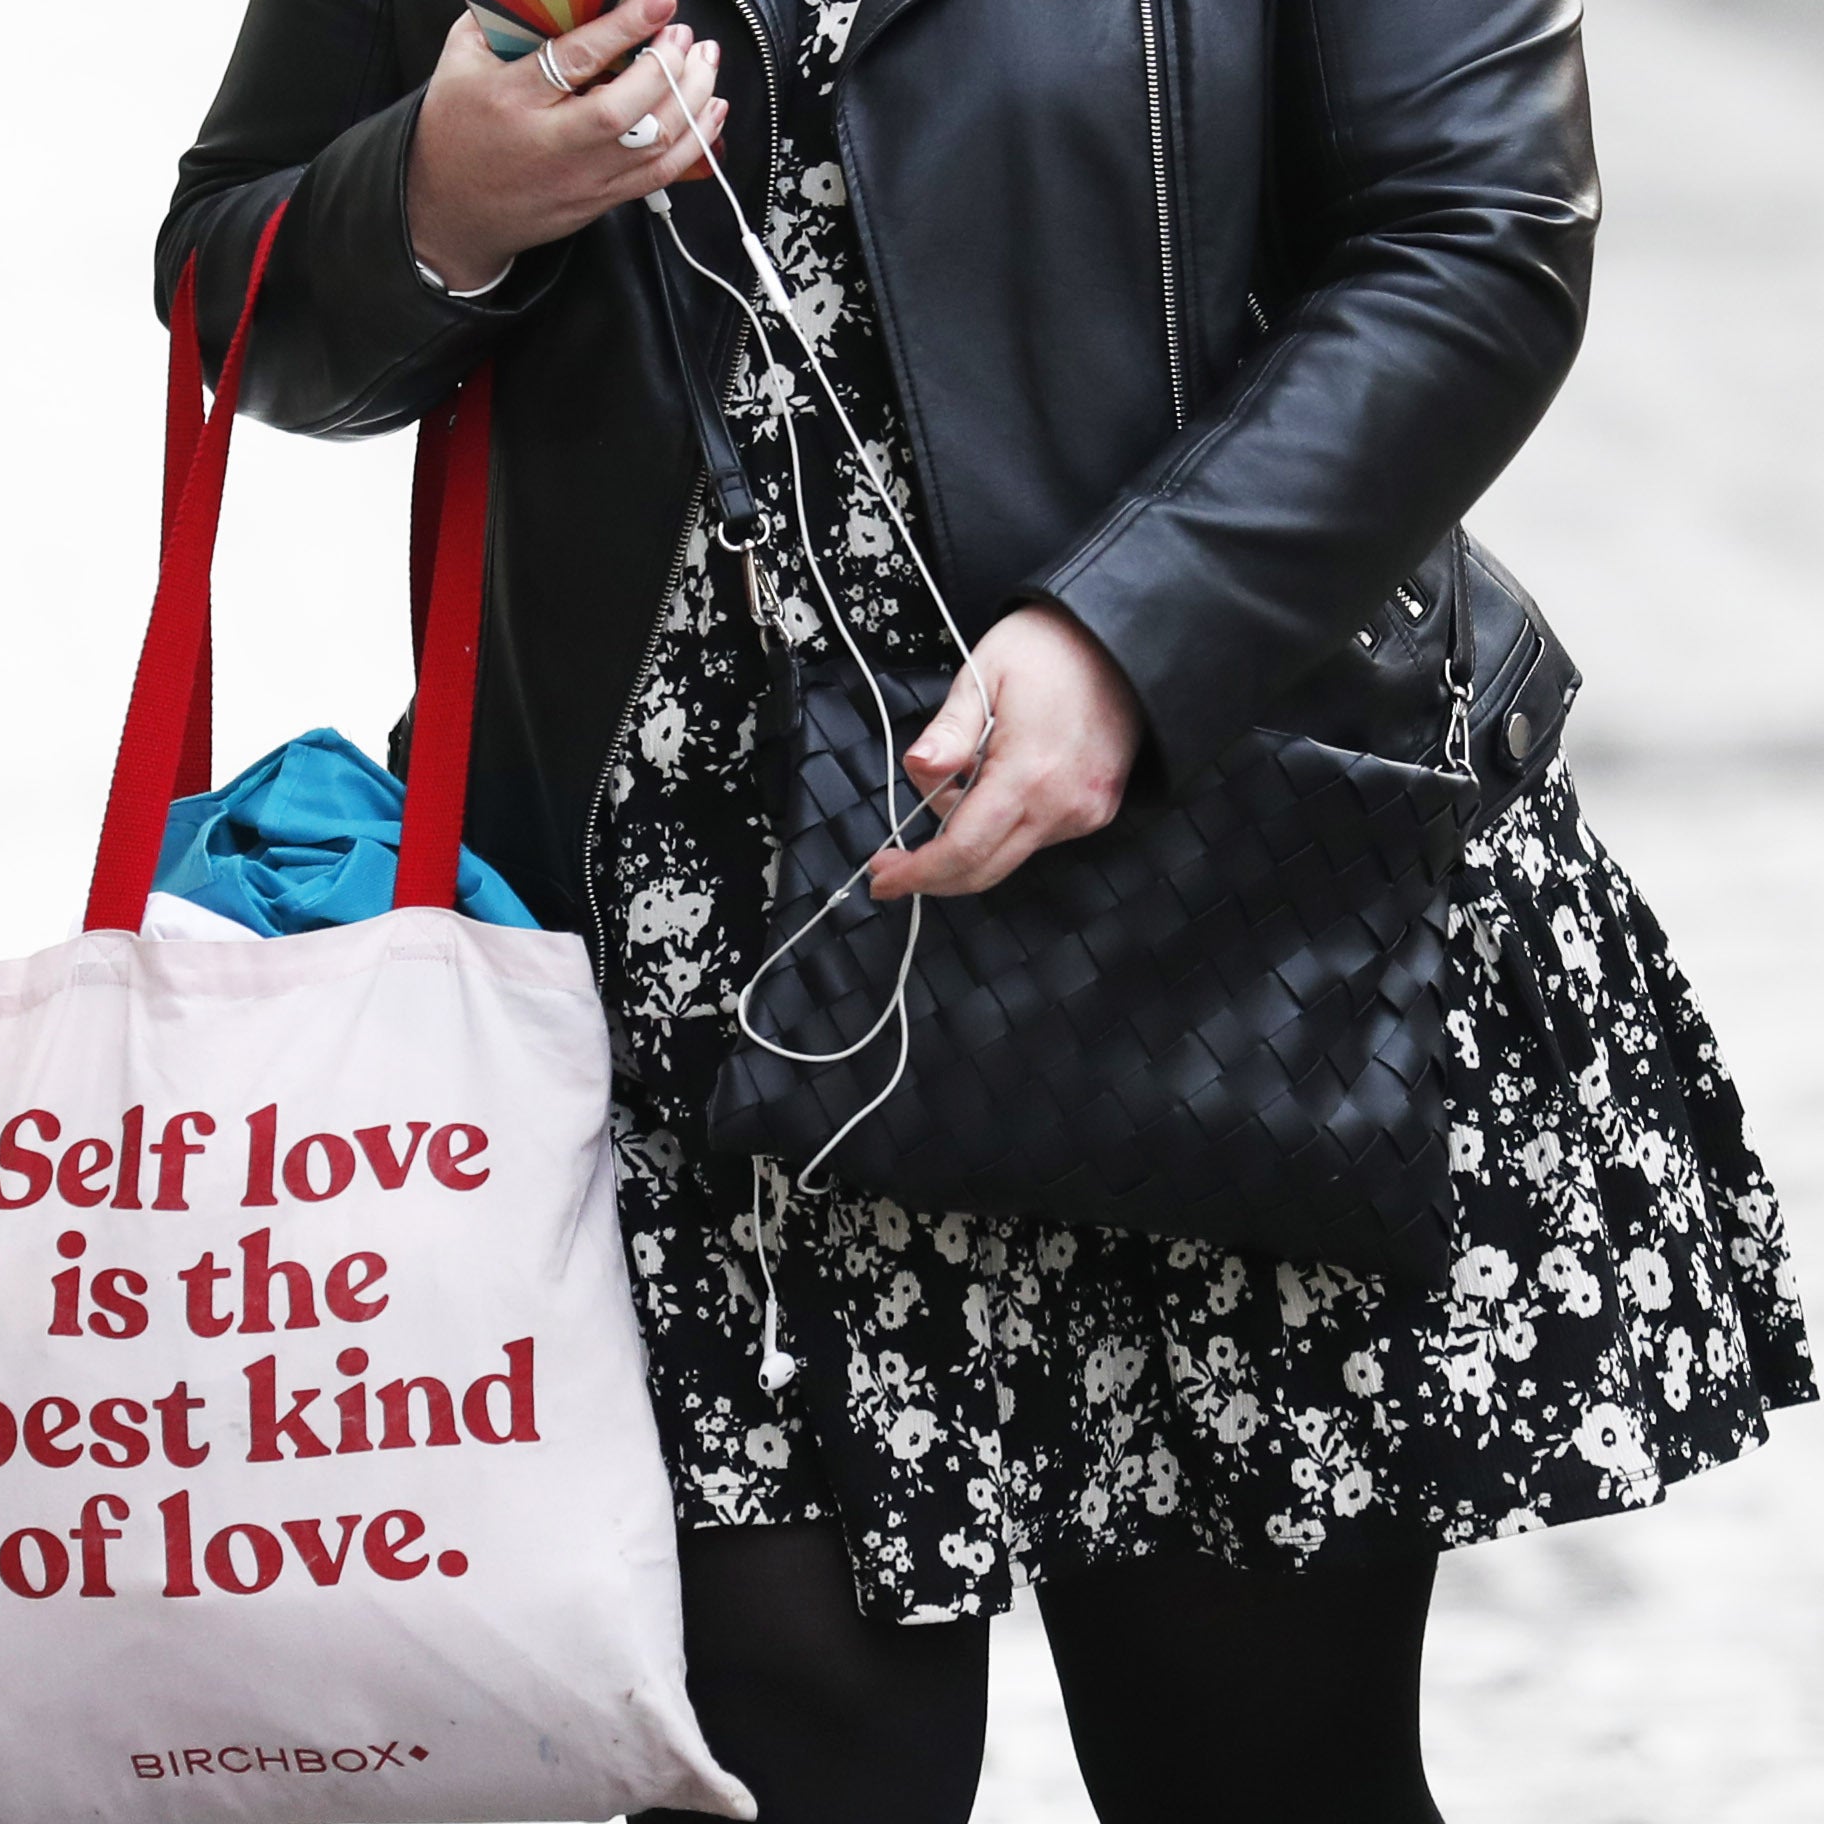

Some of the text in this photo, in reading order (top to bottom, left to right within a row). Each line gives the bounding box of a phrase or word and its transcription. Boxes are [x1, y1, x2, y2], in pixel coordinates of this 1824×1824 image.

[239, 1102, 491, 1208] love
[47, 1226, 390, 1341] is the
[243, 1336, 542, 1464] kind
[159, 1488, 470, 1599] love.
[129, 1740, 406, 1780] BIRCHBOX
